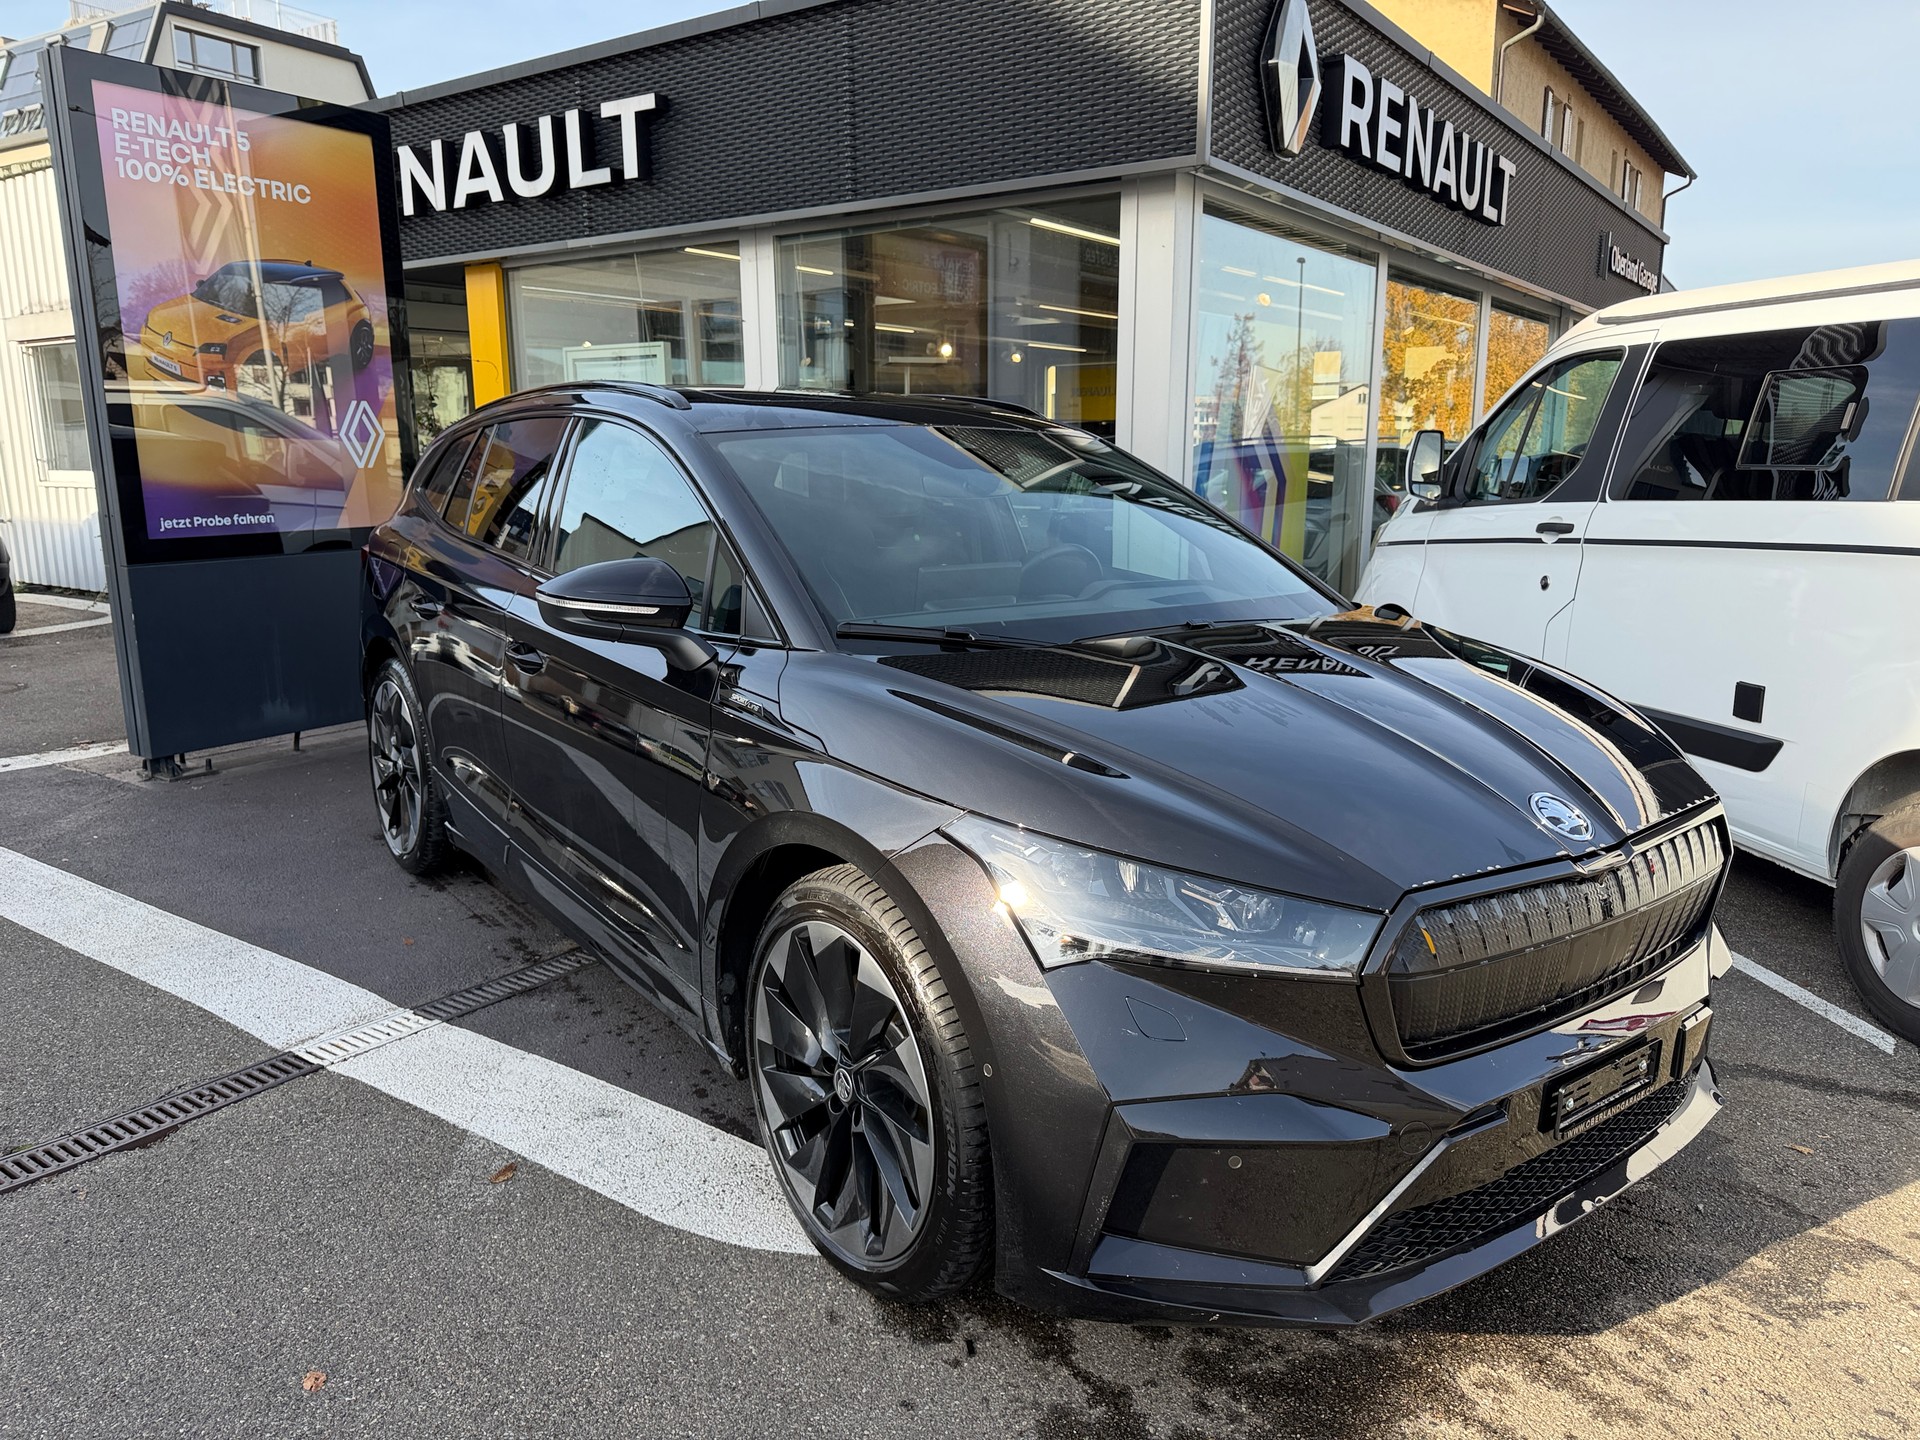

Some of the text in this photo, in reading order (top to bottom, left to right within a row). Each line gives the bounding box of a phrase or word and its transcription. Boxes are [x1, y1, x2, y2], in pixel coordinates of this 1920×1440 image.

[111, 107, 251, 151] RENAULT 5
[114, 132, 212, 168] E-TECH
[1341, 53, 1516, 226] RENAULT
[397, 93, 656, 216] NAULT
[115, 157, 311, 205] 100% ELECTRIC
[1611, 245, 1658, 296] Oberland Garage
[160, 513, 275, 532] jetzt Probe fahren
